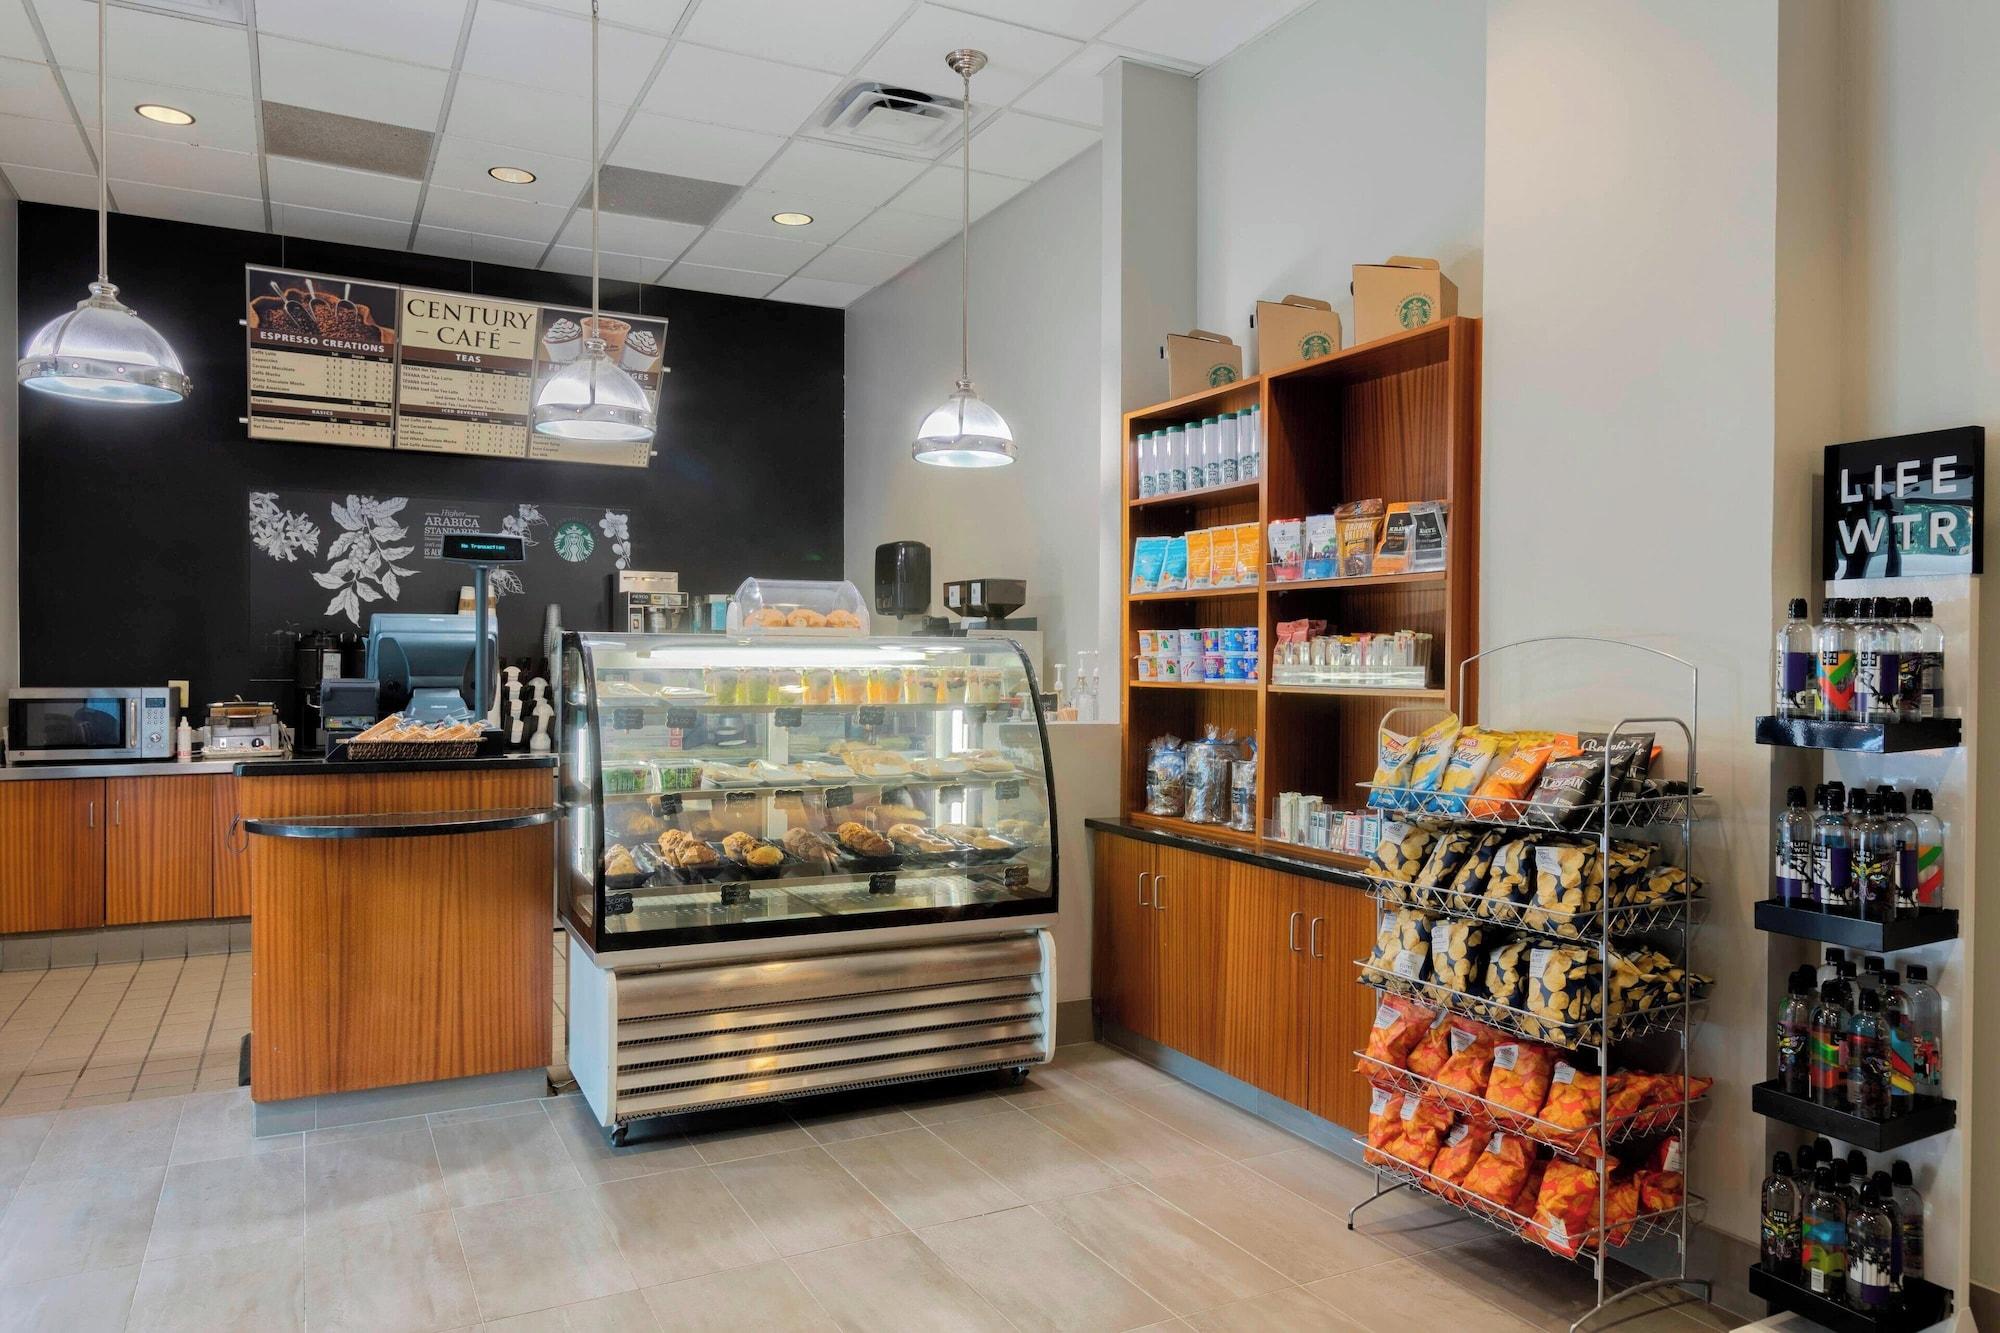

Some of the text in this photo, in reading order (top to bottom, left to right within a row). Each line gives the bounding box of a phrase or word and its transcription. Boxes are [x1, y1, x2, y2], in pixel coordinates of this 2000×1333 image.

[407, 298, 534, 330] CENTURY
[260, 332, 384, 353] ESPRESSO CREATIONS
[437, 326, 500, 350] CAFÉ
[456, 354, 481, 363] TEAS
[1840, 455, 1958, 504] LIFE
[424, 517, 480, 528] ARABICA
[440, 509, 466, 518] Higher
[1838, 511, 1957, 555] WTR
[1773, 1210, 1788, 1218] LIFE
